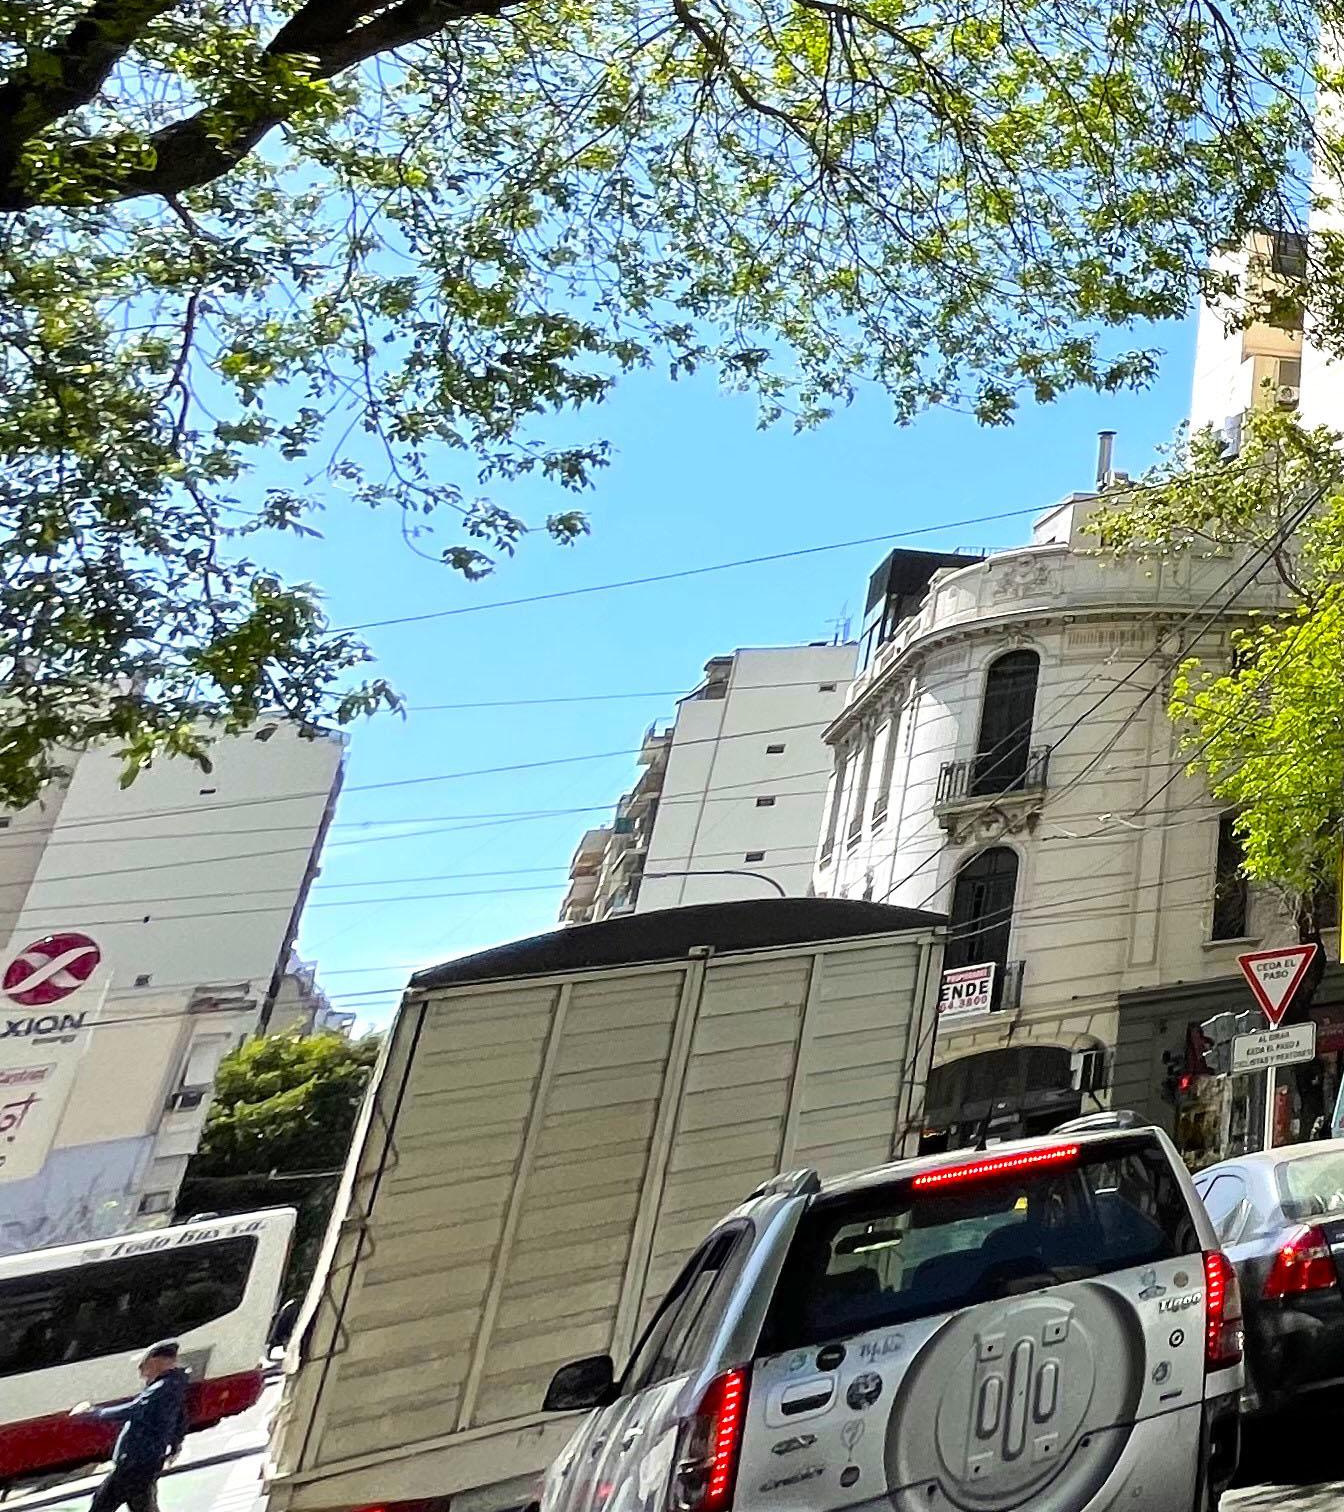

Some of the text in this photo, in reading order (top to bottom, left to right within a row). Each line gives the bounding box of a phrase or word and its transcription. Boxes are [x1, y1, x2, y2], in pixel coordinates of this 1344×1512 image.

[1256, 958, 1297, 973] CEDA EL
[1262, 969, 1290, 982] PASO
[940, 979, 990, 1002] ENDE
[0, 1010, 88, 1038] XION
[110, 1236, 171, 1257] Todo
[176, 1229, 220, 1246] Bus
